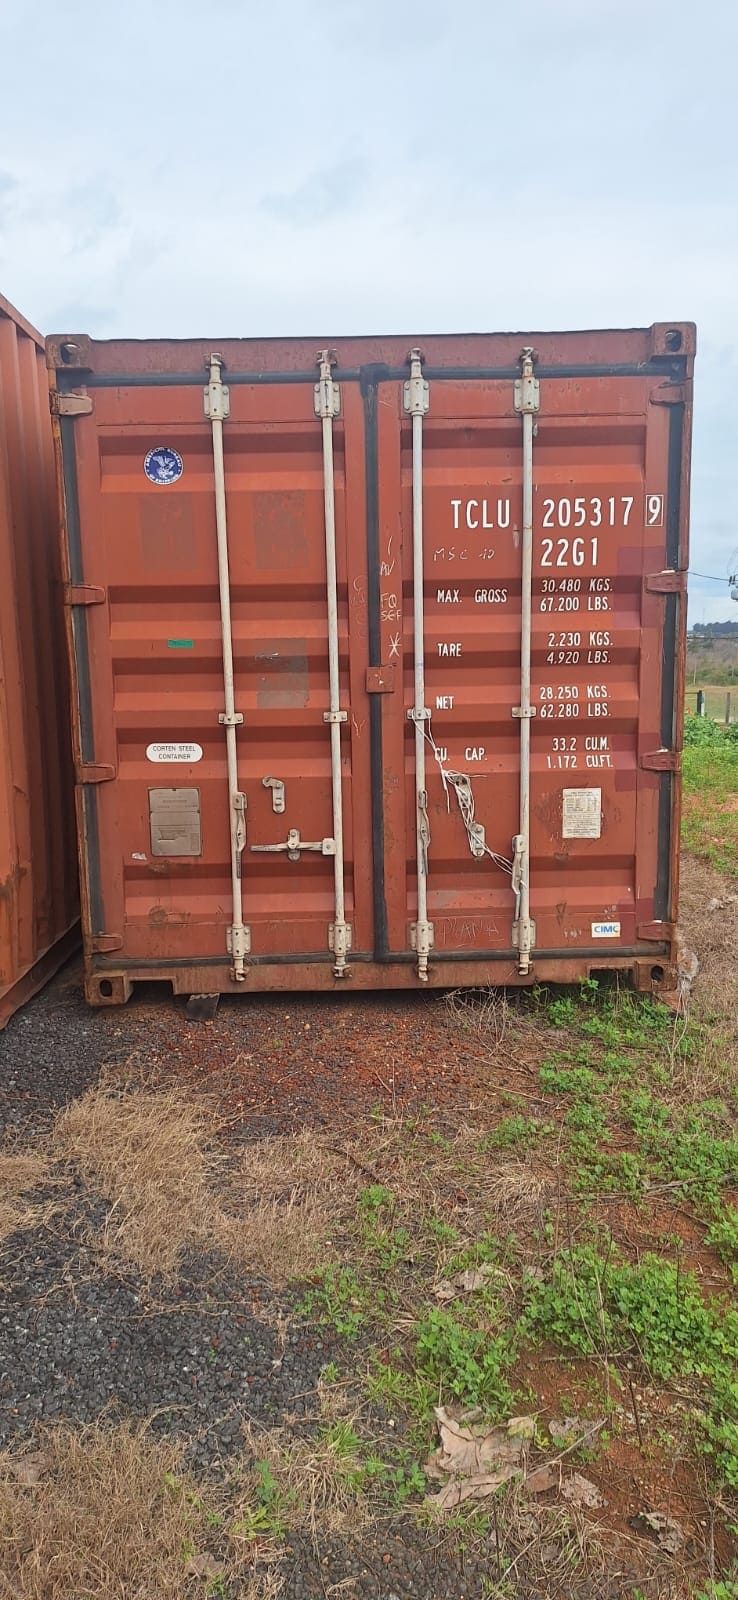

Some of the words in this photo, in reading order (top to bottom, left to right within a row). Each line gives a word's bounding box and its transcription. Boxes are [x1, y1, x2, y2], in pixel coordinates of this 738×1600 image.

[451, 499, 510, 529] TCLU
[542, 496, 634, 528] 205317
[647, 495, 662, 526] 9
[540, 537, 598, 567] 22G1
[541, 579, 581, 592] 30.480
[589, 578, 613, 592] KGS.
[437, 589, 462, 603] MAX.
[474, 589, 507, 603] GROSS
[540, 597, 580, 611] 67.200
[587, 597, 611, 611] LBS.
[548, 632, 581, 647] 2.230
[589, 632, 613, 646] KGS.
[437, 643, 462, 657] TARE
[546, 651, 579, 665] 4.920
[587, 651, 611, 664] LBS.
[539, 686, 578, 700] 28.250
[587, 685, 611, 699] KGS.
[436, 696, 454, 709] NET
[540, 703, 579, 718] 62.280
[587, 703, 611, 717] LBS.
[552, 737, 577, 751] 33.2
[585, 737, 610, 750] CU.M.
[435, 747, 450, 761] CU.
[465, 747, 488, 761] CAP.
[546, 755, 577, 769] 1.172
[594, 925, 619, 933] CIMC
